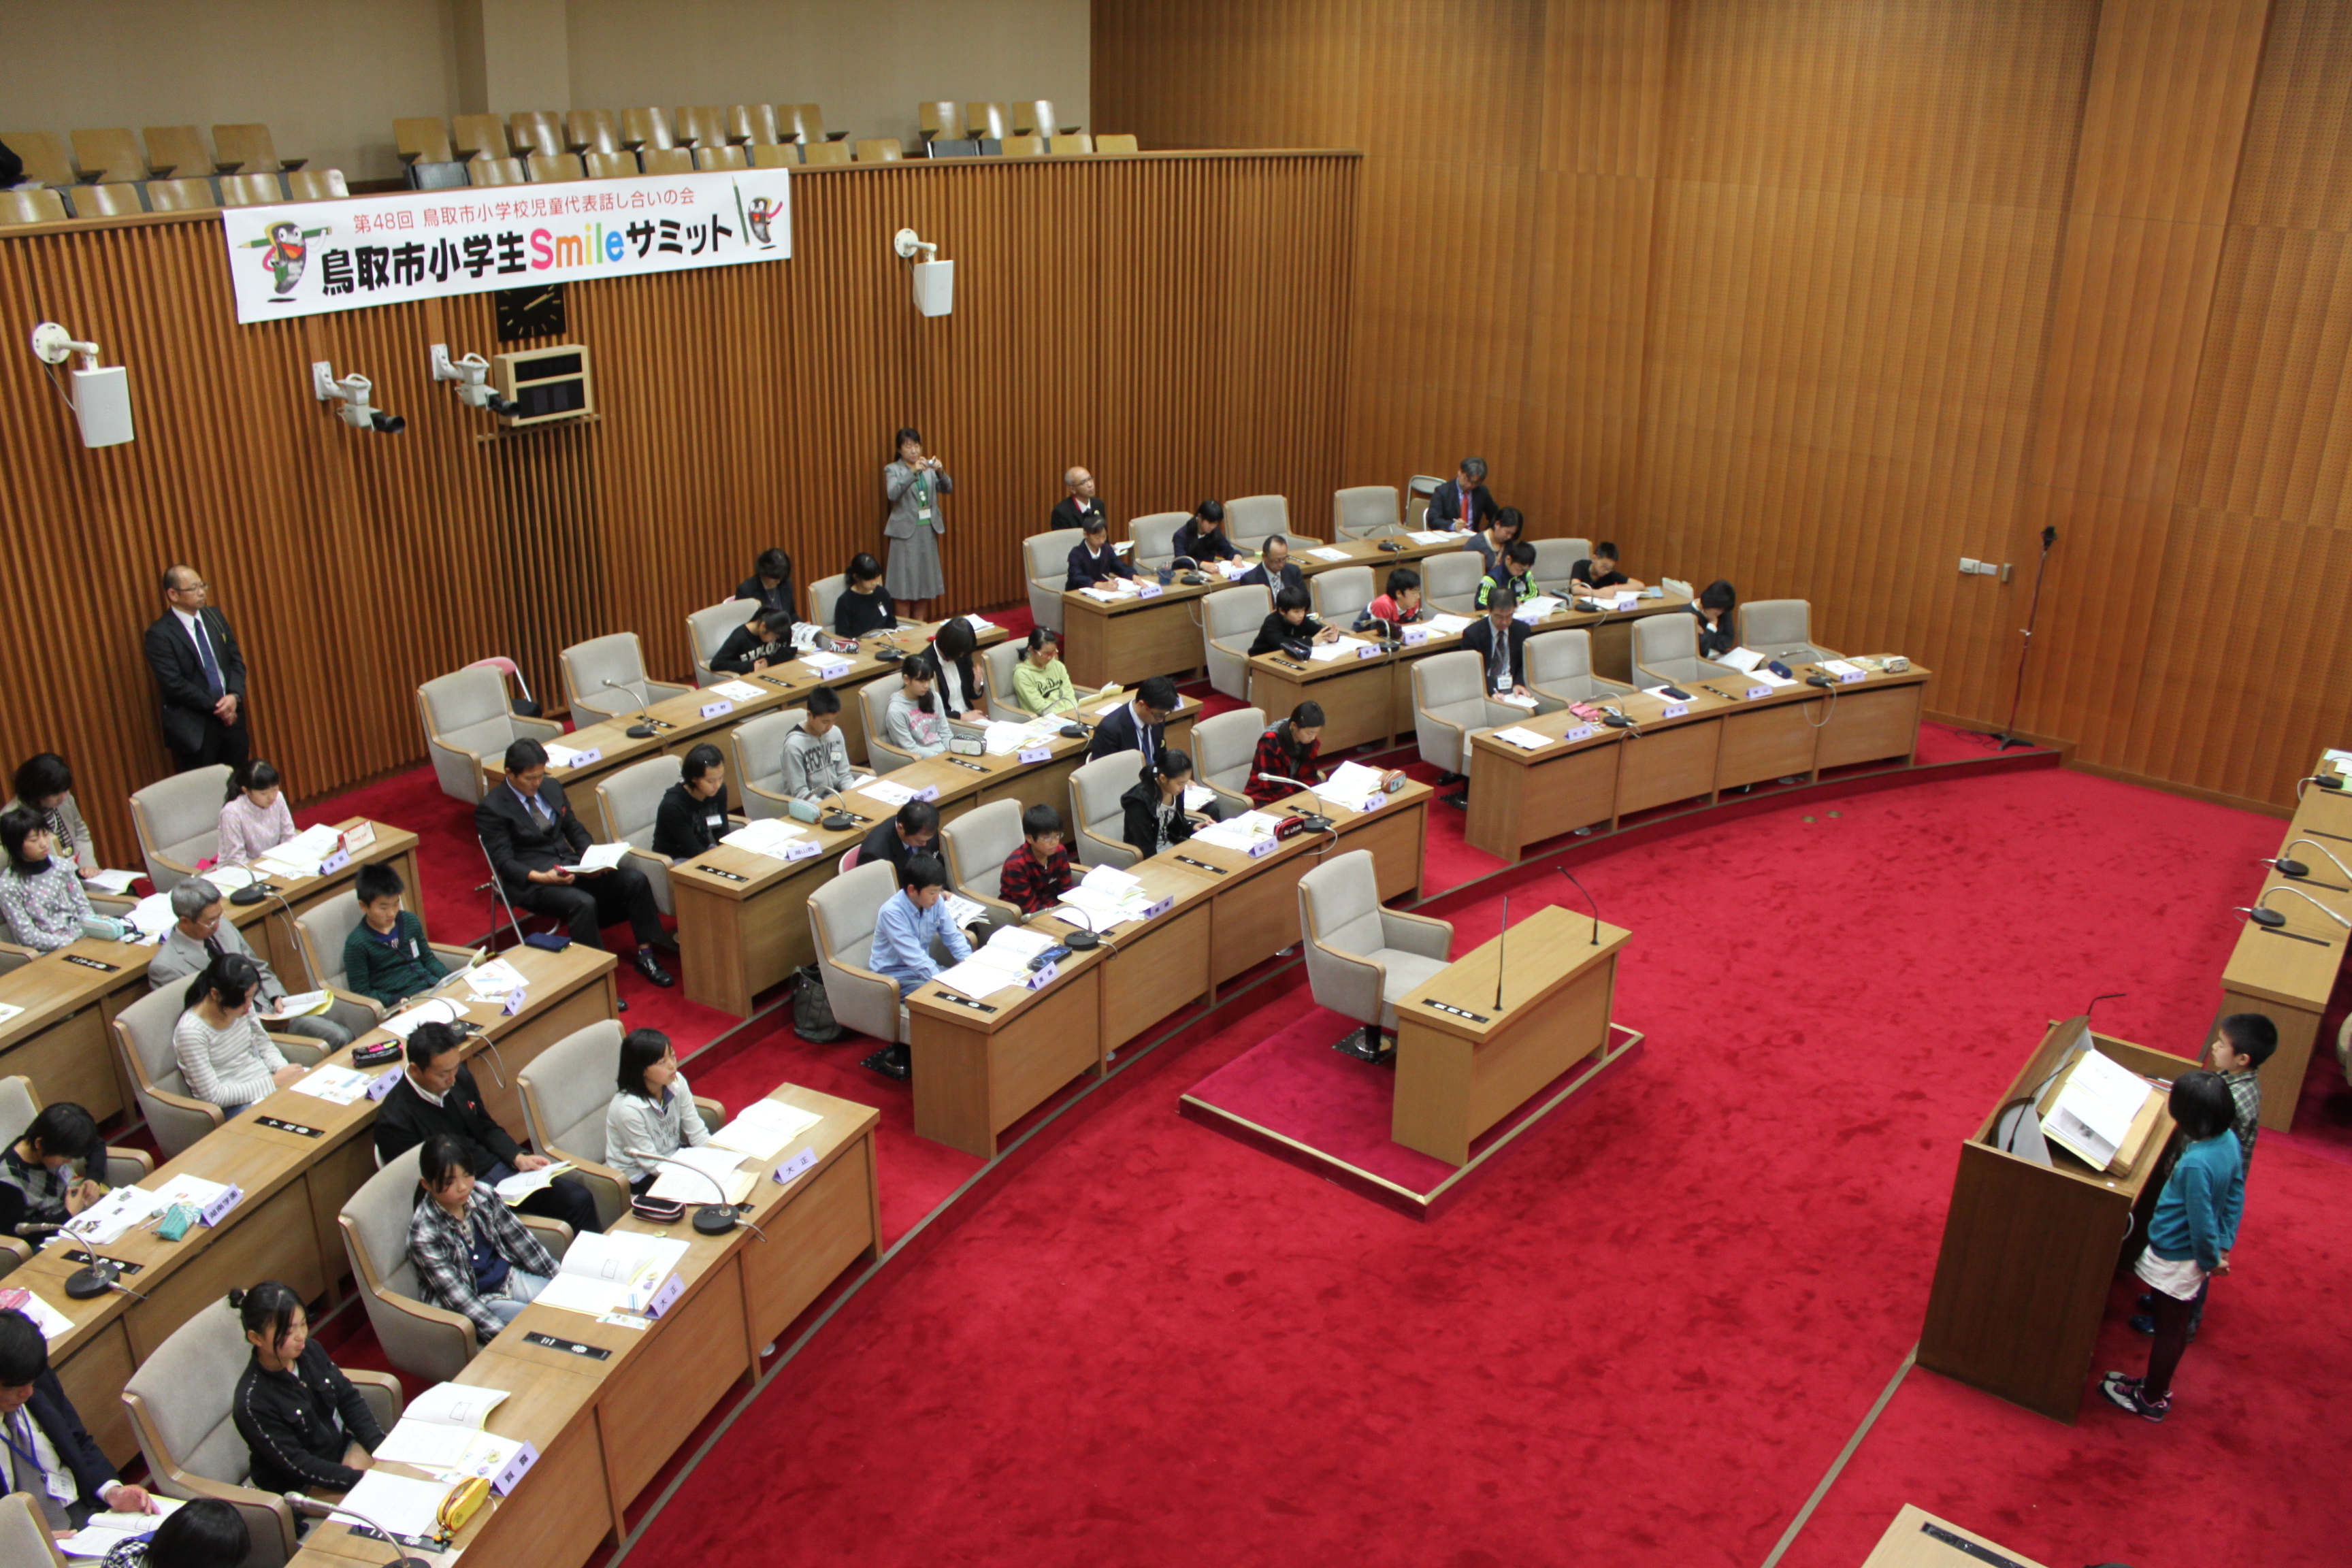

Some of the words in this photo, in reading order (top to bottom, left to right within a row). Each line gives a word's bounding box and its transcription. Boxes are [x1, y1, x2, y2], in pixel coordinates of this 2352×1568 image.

[353, 210, 414, 234] 第48回
[423, 186, 695, 228] 鳥取市小学校児童代表話し合いの会
[785, 1156, 809, 1175] 大正
[208, 1190, 238, 1220] 湖南学園
[659, 1284, 679, 1308] 大正
